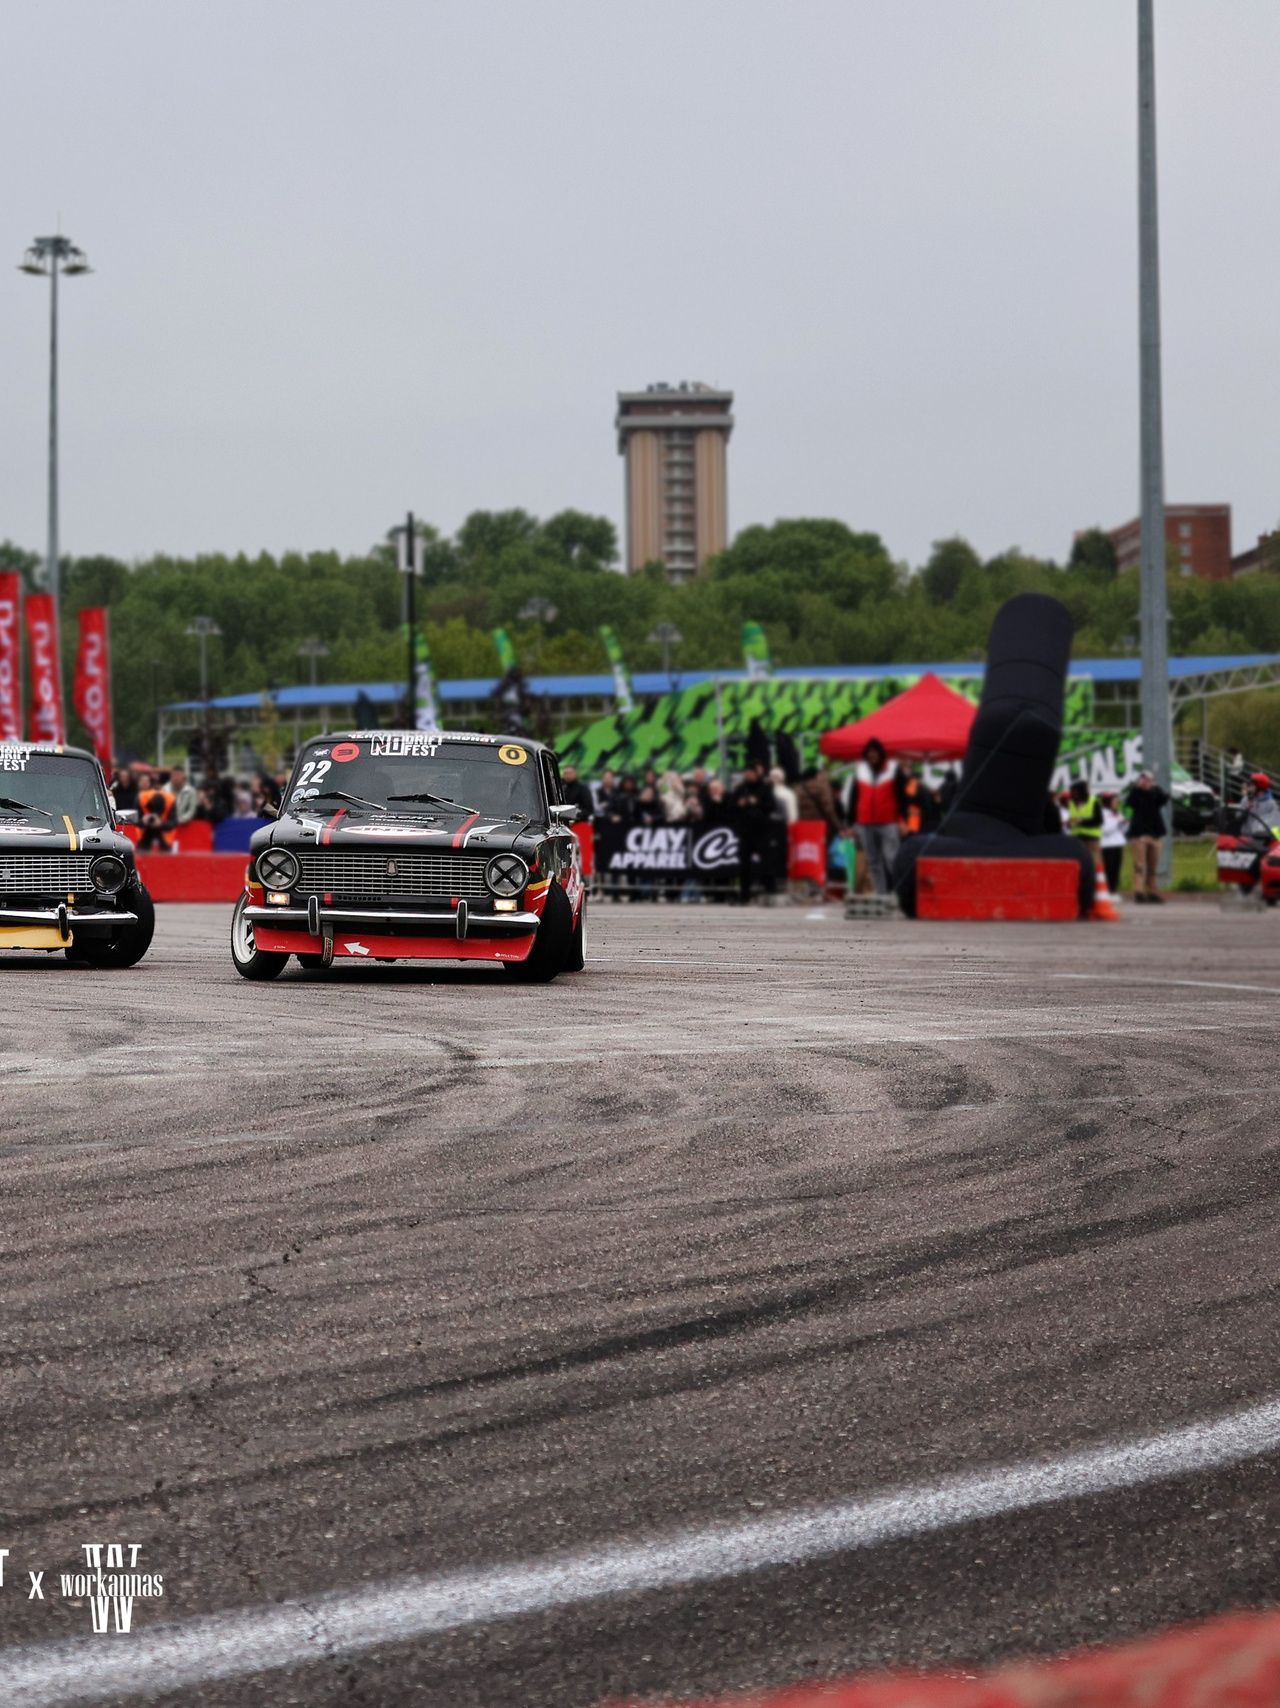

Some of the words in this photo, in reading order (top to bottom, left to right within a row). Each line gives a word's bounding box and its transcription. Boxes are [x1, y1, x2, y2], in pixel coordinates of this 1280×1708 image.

[405, 735, 443, 746] DRIFT
[404, 745, 438, 757] FEST
[296, 760, 332, 787] 22
[609, 852, 687, 870] APPAREL
